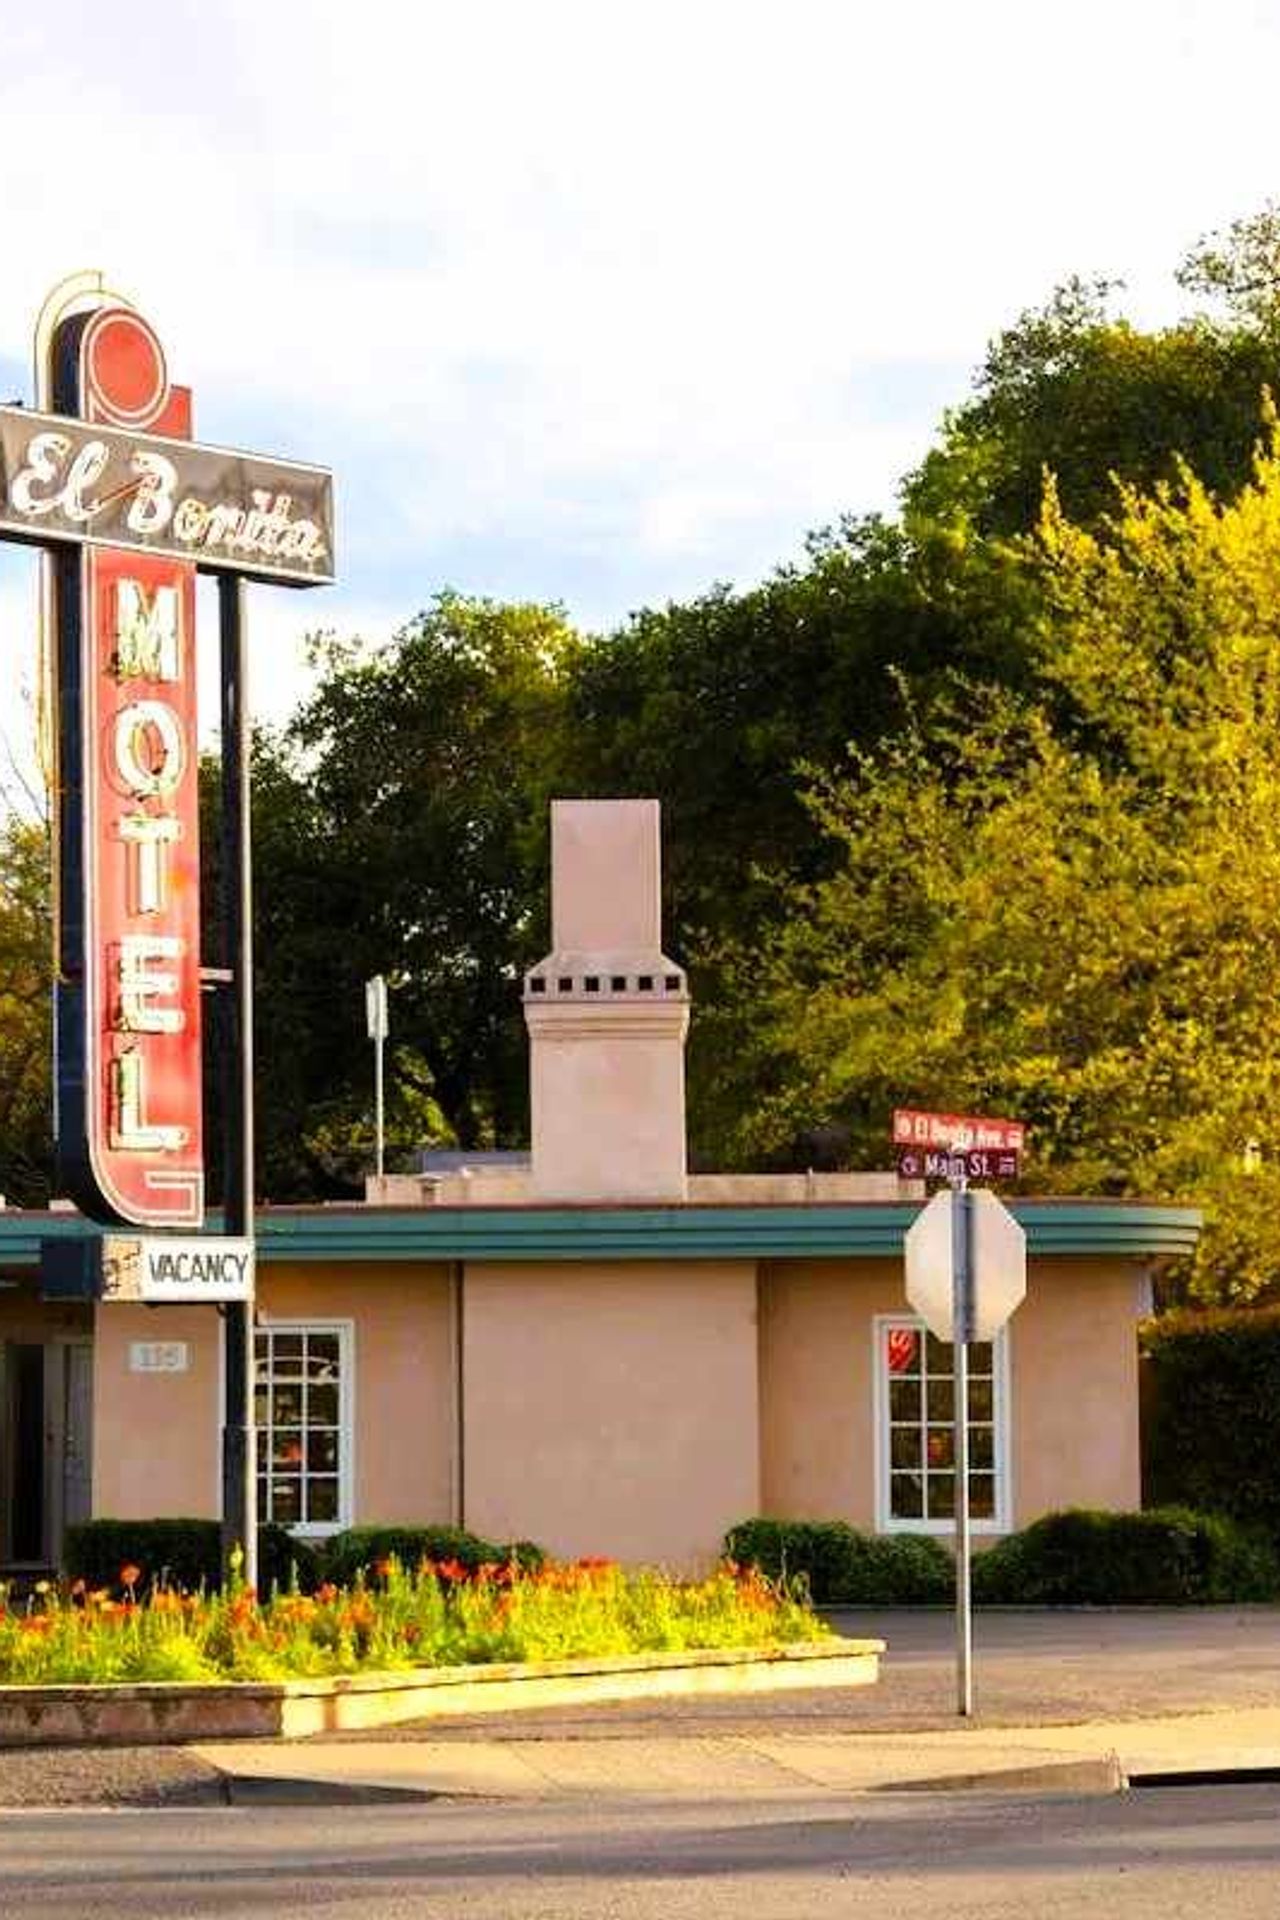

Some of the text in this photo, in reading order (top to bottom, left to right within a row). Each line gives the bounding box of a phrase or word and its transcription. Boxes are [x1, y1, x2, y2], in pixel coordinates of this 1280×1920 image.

[12, 432, 325, 561] El Bonita
[106, 577, 188, 1152] MOTEL
[925, 1153, 964, 1176] Main
[970, 1152, 992, 1175] St.
[149, 1253, 248, 1283] VACANCY
